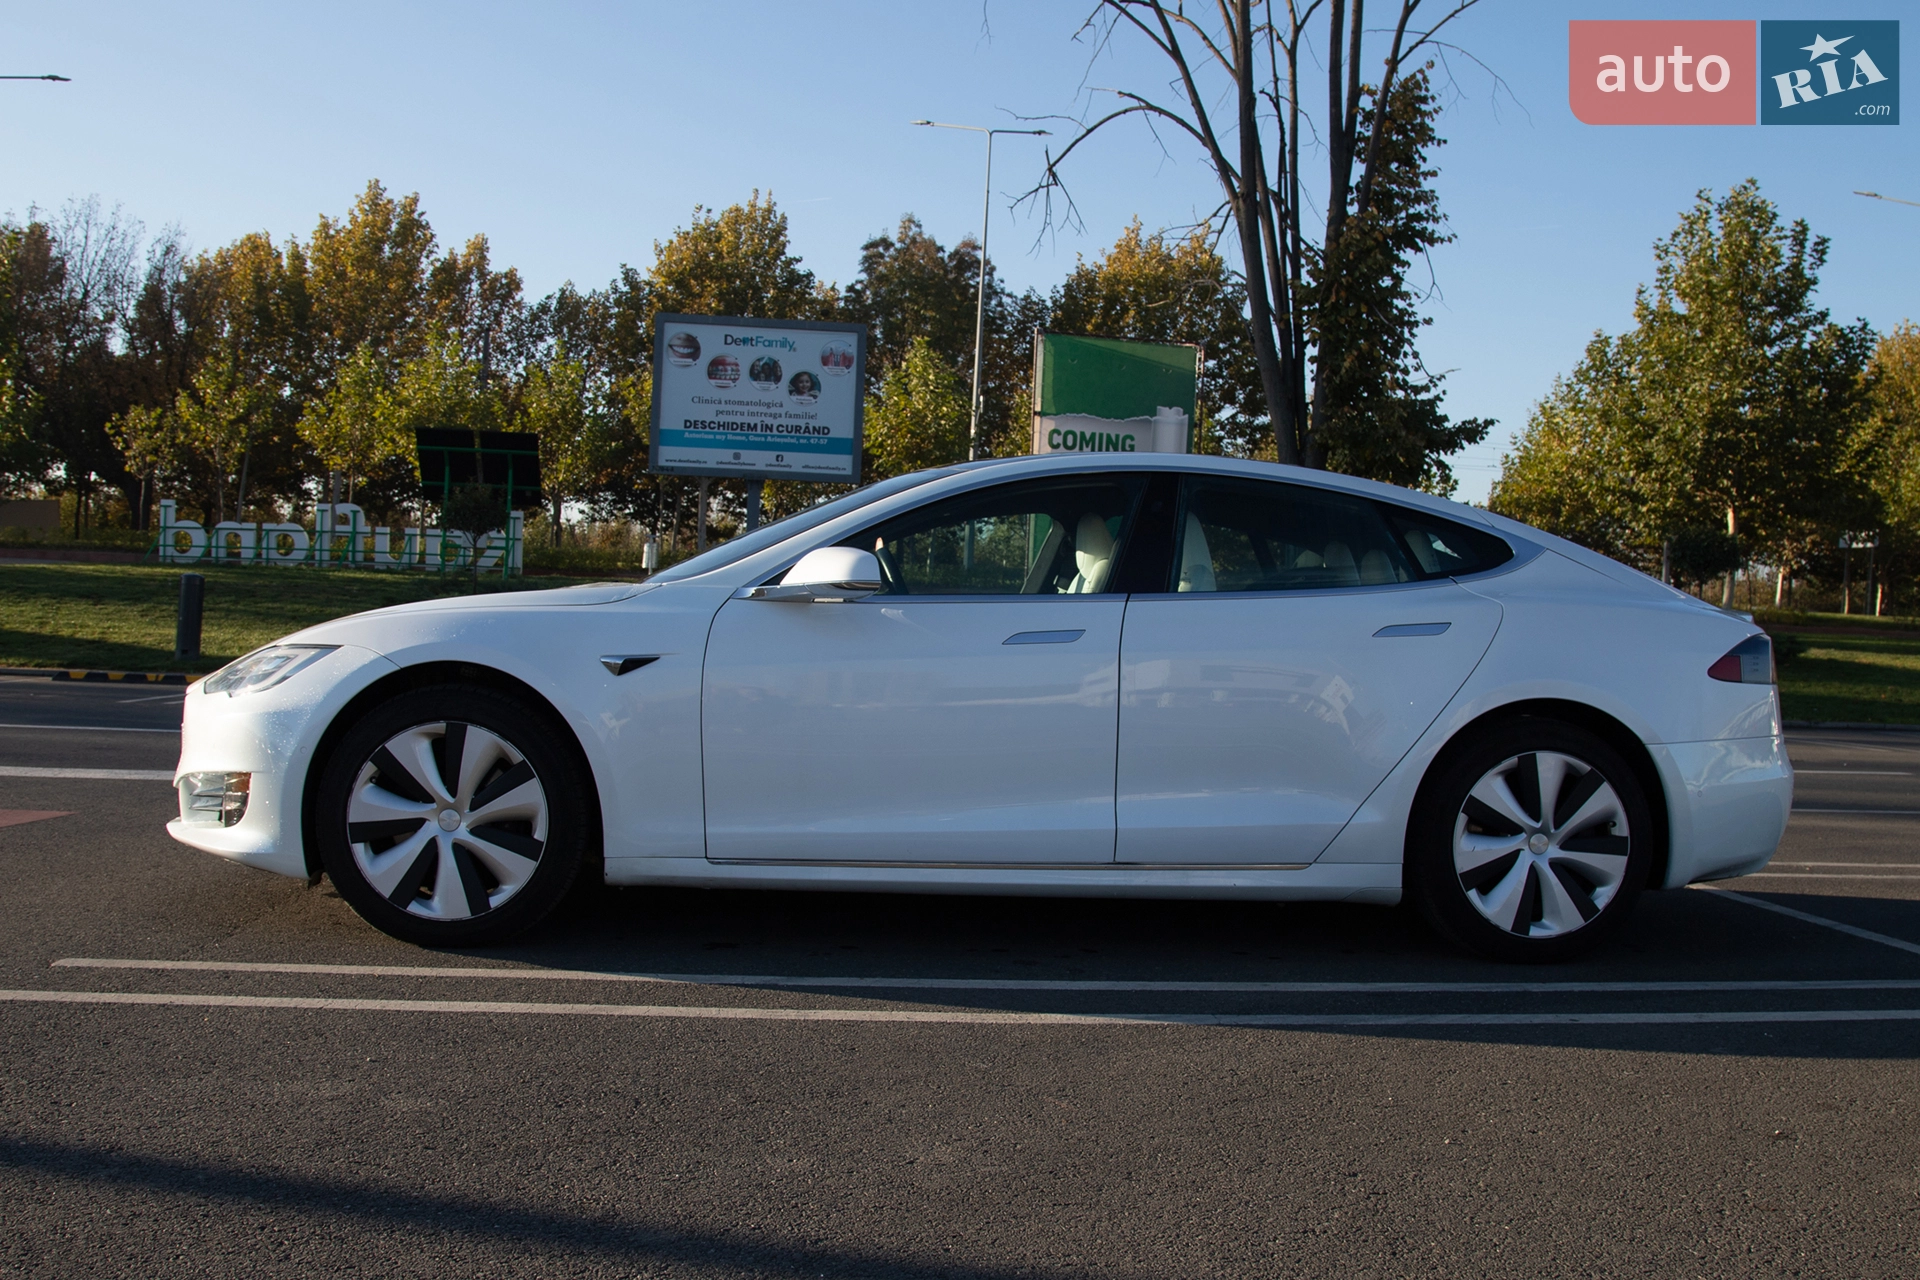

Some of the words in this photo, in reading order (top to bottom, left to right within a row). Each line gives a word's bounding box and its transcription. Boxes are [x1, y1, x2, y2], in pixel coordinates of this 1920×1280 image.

[724, 398, 784, 409] stomatologică
[715, 408, 745, 418] pentru
[784, 411, 818, 421] familie!
[684, 419, 758, 432] DESCHIDEM
[760, 420, 774, 433] ÎN
[776, 422, 831, 436] CURÂND
[1047, 428, 1136, 452] COMING
